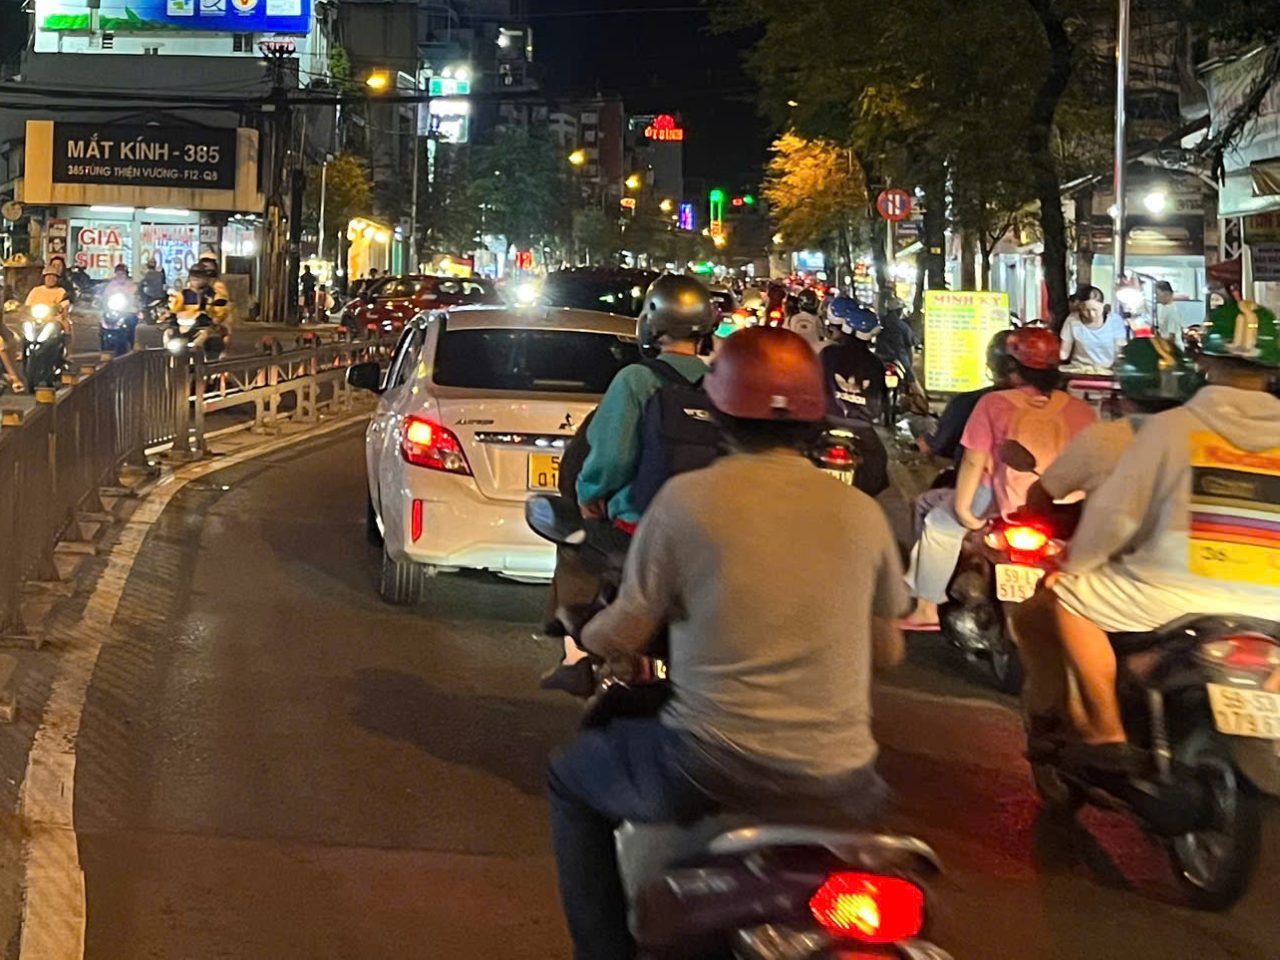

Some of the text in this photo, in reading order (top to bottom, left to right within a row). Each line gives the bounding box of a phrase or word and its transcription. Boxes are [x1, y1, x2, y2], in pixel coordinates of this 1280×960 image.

[67, 132, 114, 160] MẮT
[120, 136, 169, 161] KÍNH
[184, 144, 220, 164] 385
[67, 165, 84, 176] 385
